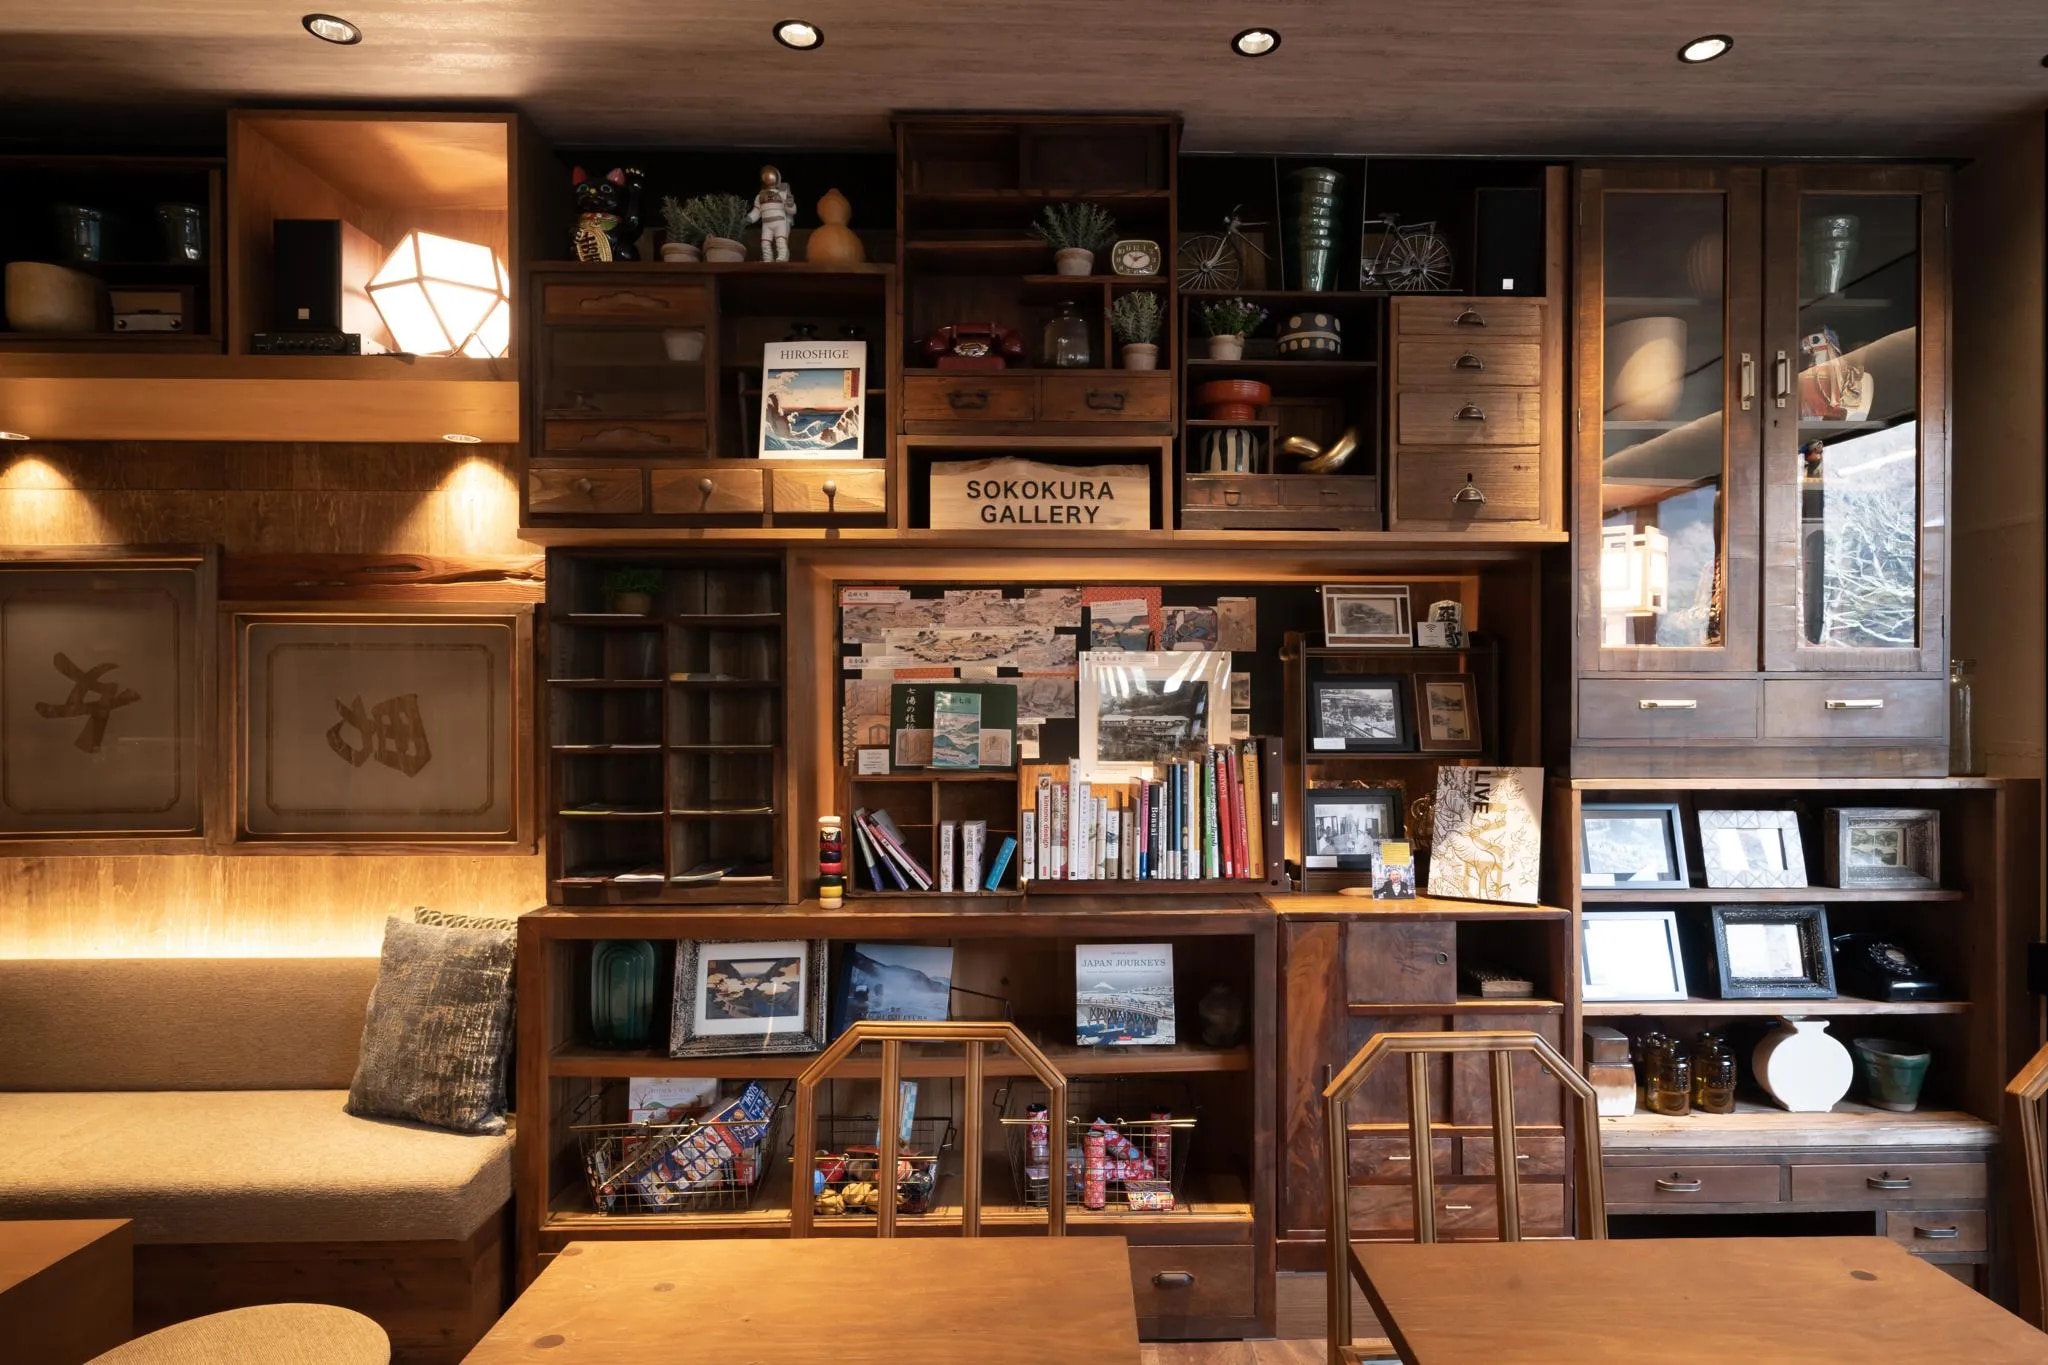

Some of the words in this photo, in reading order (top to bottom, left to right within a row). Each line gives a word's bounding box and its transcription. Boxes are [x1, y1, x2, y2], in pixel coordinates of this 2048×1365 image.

[780, 349, 849, 360] HIROSHIGE
[966, 480, 1114, 500] SOKOKURA
[980, 505, 1101, 524] GALLERY
[326, 693, 432, 778] 男
[1473, 770, 1491, 814] LIVE
[1150, 807, 1159, 836] Bonsai
[1042, 824, 1050, 849] design
[1082, 959, 1113, 968] JAPAN
[1115, 958, 1167, 967] JOURNEYS
